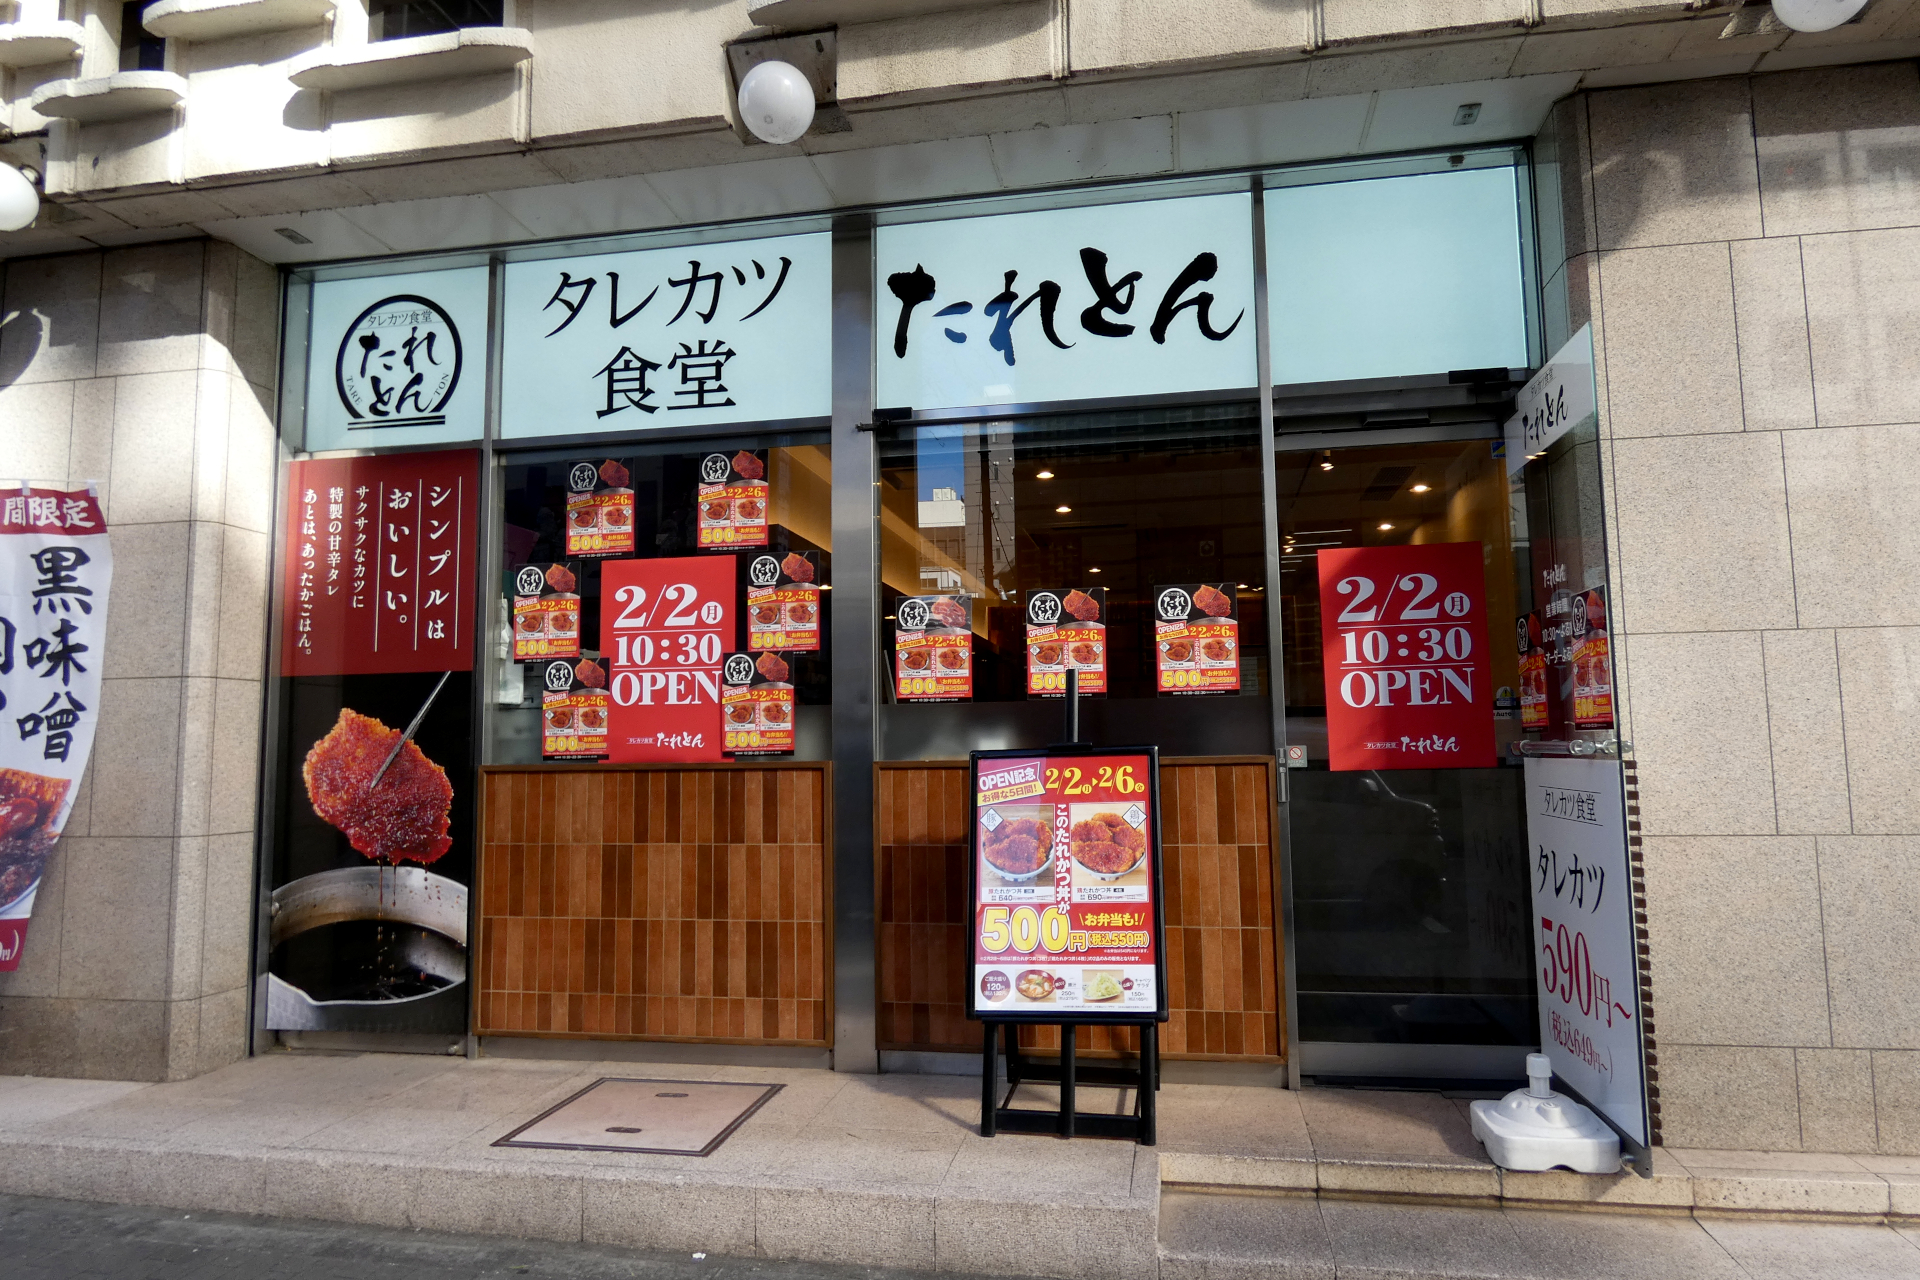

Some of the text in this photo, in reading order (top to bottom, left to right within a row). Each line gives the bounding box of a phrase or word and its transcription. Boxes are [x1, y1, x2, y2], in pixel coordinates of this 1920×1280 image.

[368, 310, 433, 327] タレカツ食堂
[542, 256, 792, 338] タレカツ
[886, 246, 1245, 366] たれとん
[358, 326, 442, 378] たれ
[346, 375, 362, 406] TARE
[434, 372, 449, 396] TON
[592, 339, 737, 419] 食堂
[326, 486, 344, 596] 特製の甘辛タレ
[352, 485, 370, 609] サクサクなカツに
[386, 488, 413, 624] おいしい。
[298, 488, 317, 655] あとは、あったかごはん。
[424, 486, 452, 640] シンプルは
[16, 545, 94, 763] 黒味噌
[614, 633, 722, 666] 10:30
[1341, 627, 1472, 664] 10:30
[611, 670, 722, 706] OPEN
[1340, 667, 1475, 708] OPEN
[656, 731, 705, 749] たれとん
[1400, 734, 1460, 754] たれとん
[979, 767, 1036, 791] OPEN記念
[981, 785, 1038, 803] お得な5日間!
[1544, 789, 1596, 822] タレカツ食堂
[1056, 804, 1071, 914] このたれかつ丼が
[1537, 844, 1604, 913] タレカツ
[981, 906, 1087, 952] 500円
[1088, 932, 1149, 947] (税込550円)
